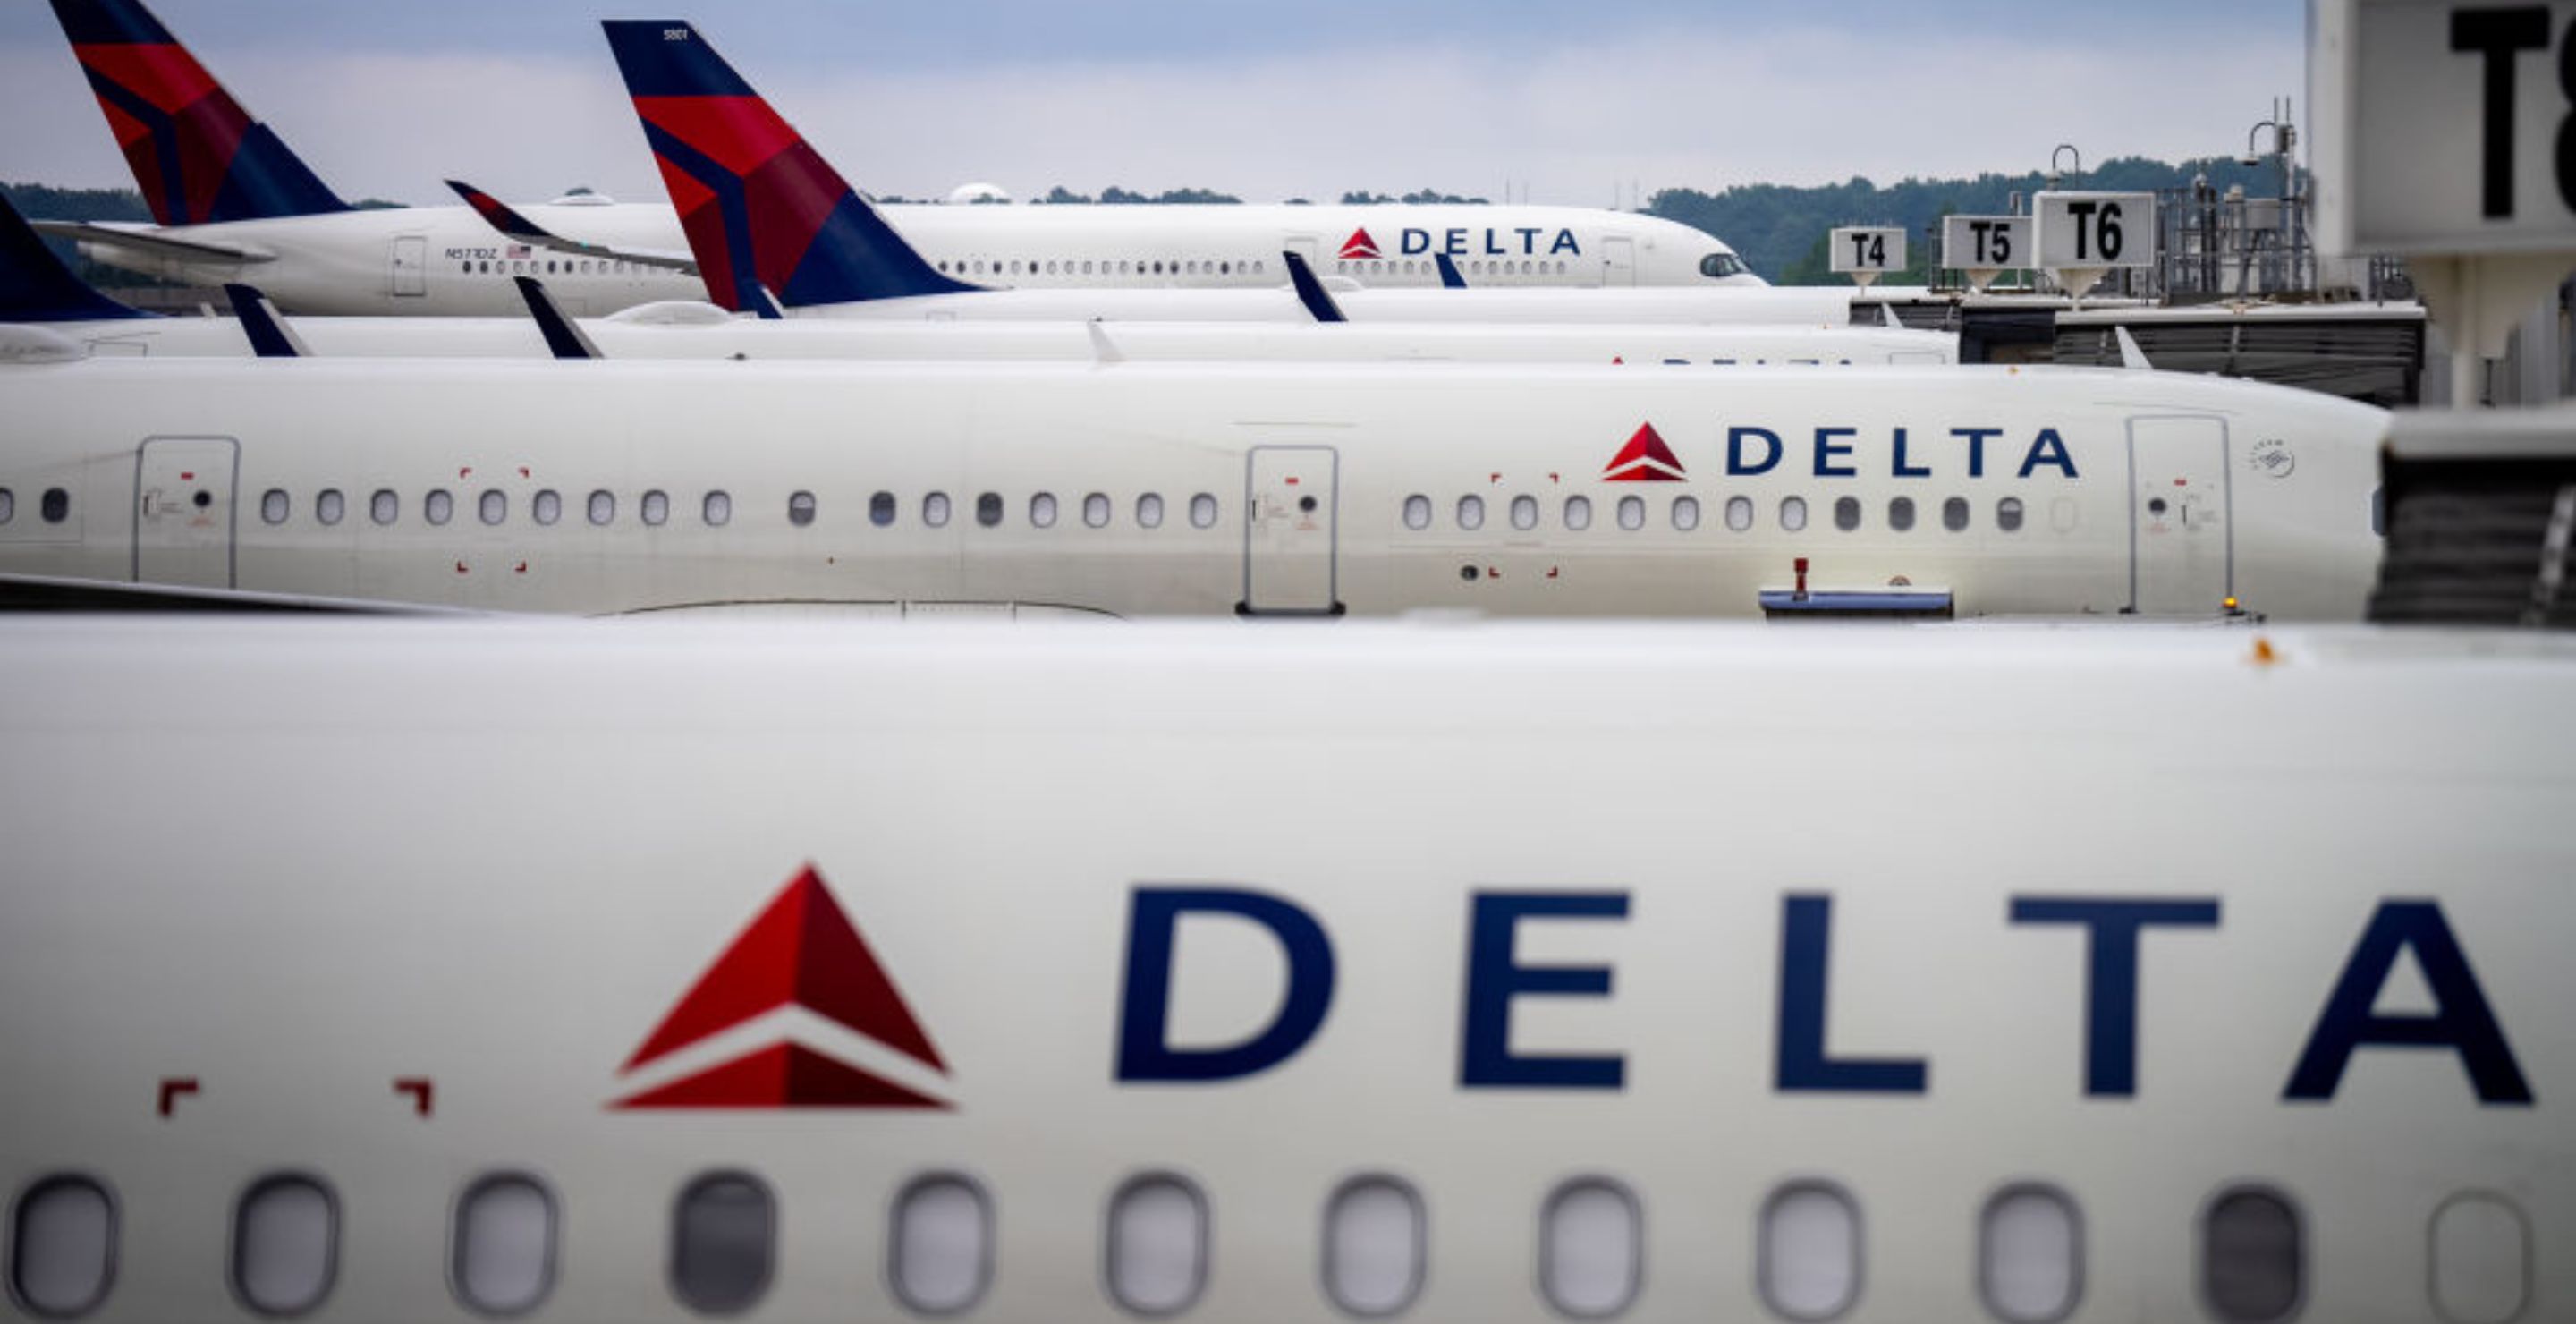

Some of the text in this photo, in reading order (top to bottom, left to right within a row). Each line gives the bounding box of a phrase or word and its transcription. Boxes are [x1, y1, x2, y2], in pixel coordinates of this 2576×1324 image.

[2449, 6, 2576, 219] T
[1401, 228, 1580, 255] DELTA
[1852, 233, 1885, 267] T4
[1970, 221, 2010, 264] T5
[2068, 201, 2122, 261] T6
[1726, 427, 2079, 478] DELTA
[1113, 885, 2536, 1106] DELTA
